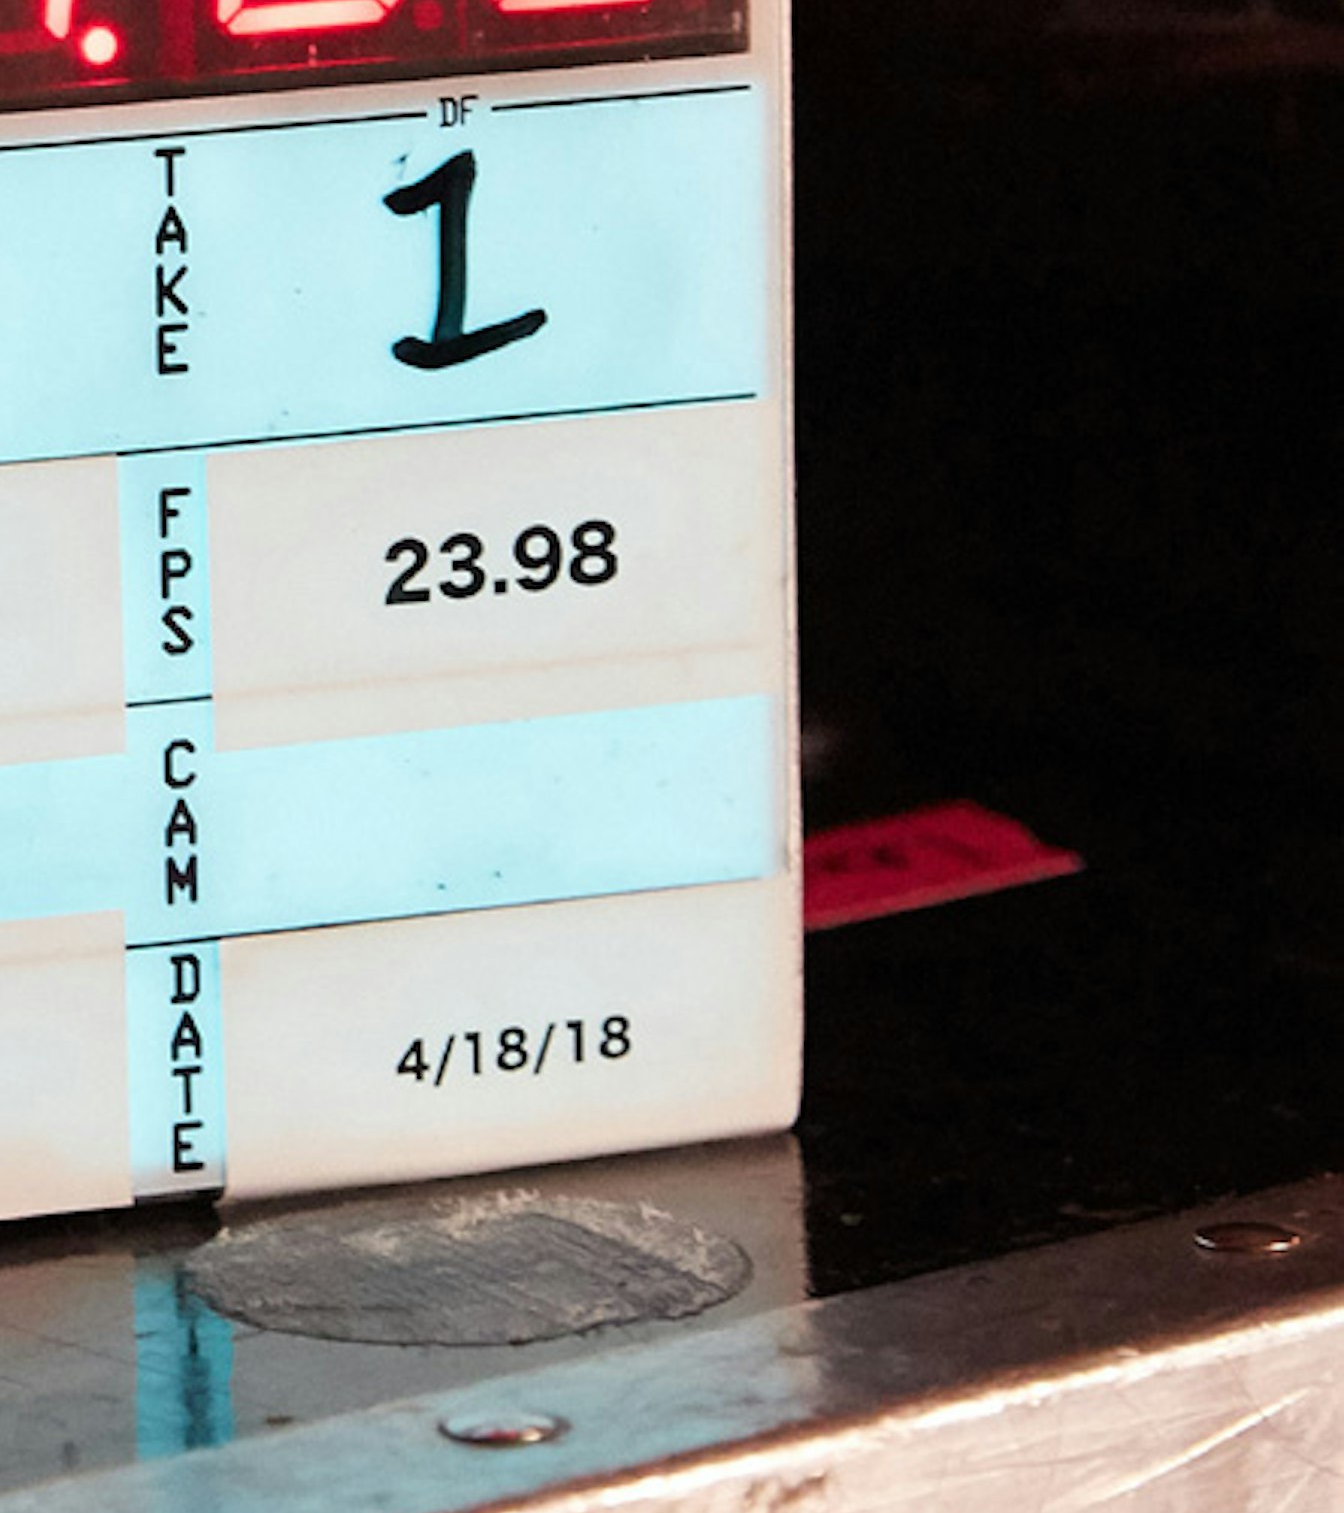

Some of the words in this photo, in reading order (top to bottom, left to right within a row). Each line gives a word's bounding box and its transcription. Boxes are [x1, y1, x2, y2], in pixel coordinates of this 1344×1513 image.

[438, 94, 479, 128] DF
[154, 146, 190, 375] TAKE
[382, 149, 549, 370] 1
[159, 487, 194, 656] FPS
[385, 520, 619, 605] 23.98
[163, 739, 198, 905] CAM
[169, 953, 205, 1174] DATE
[396, 1015, 632, 1087] 4/18/18
